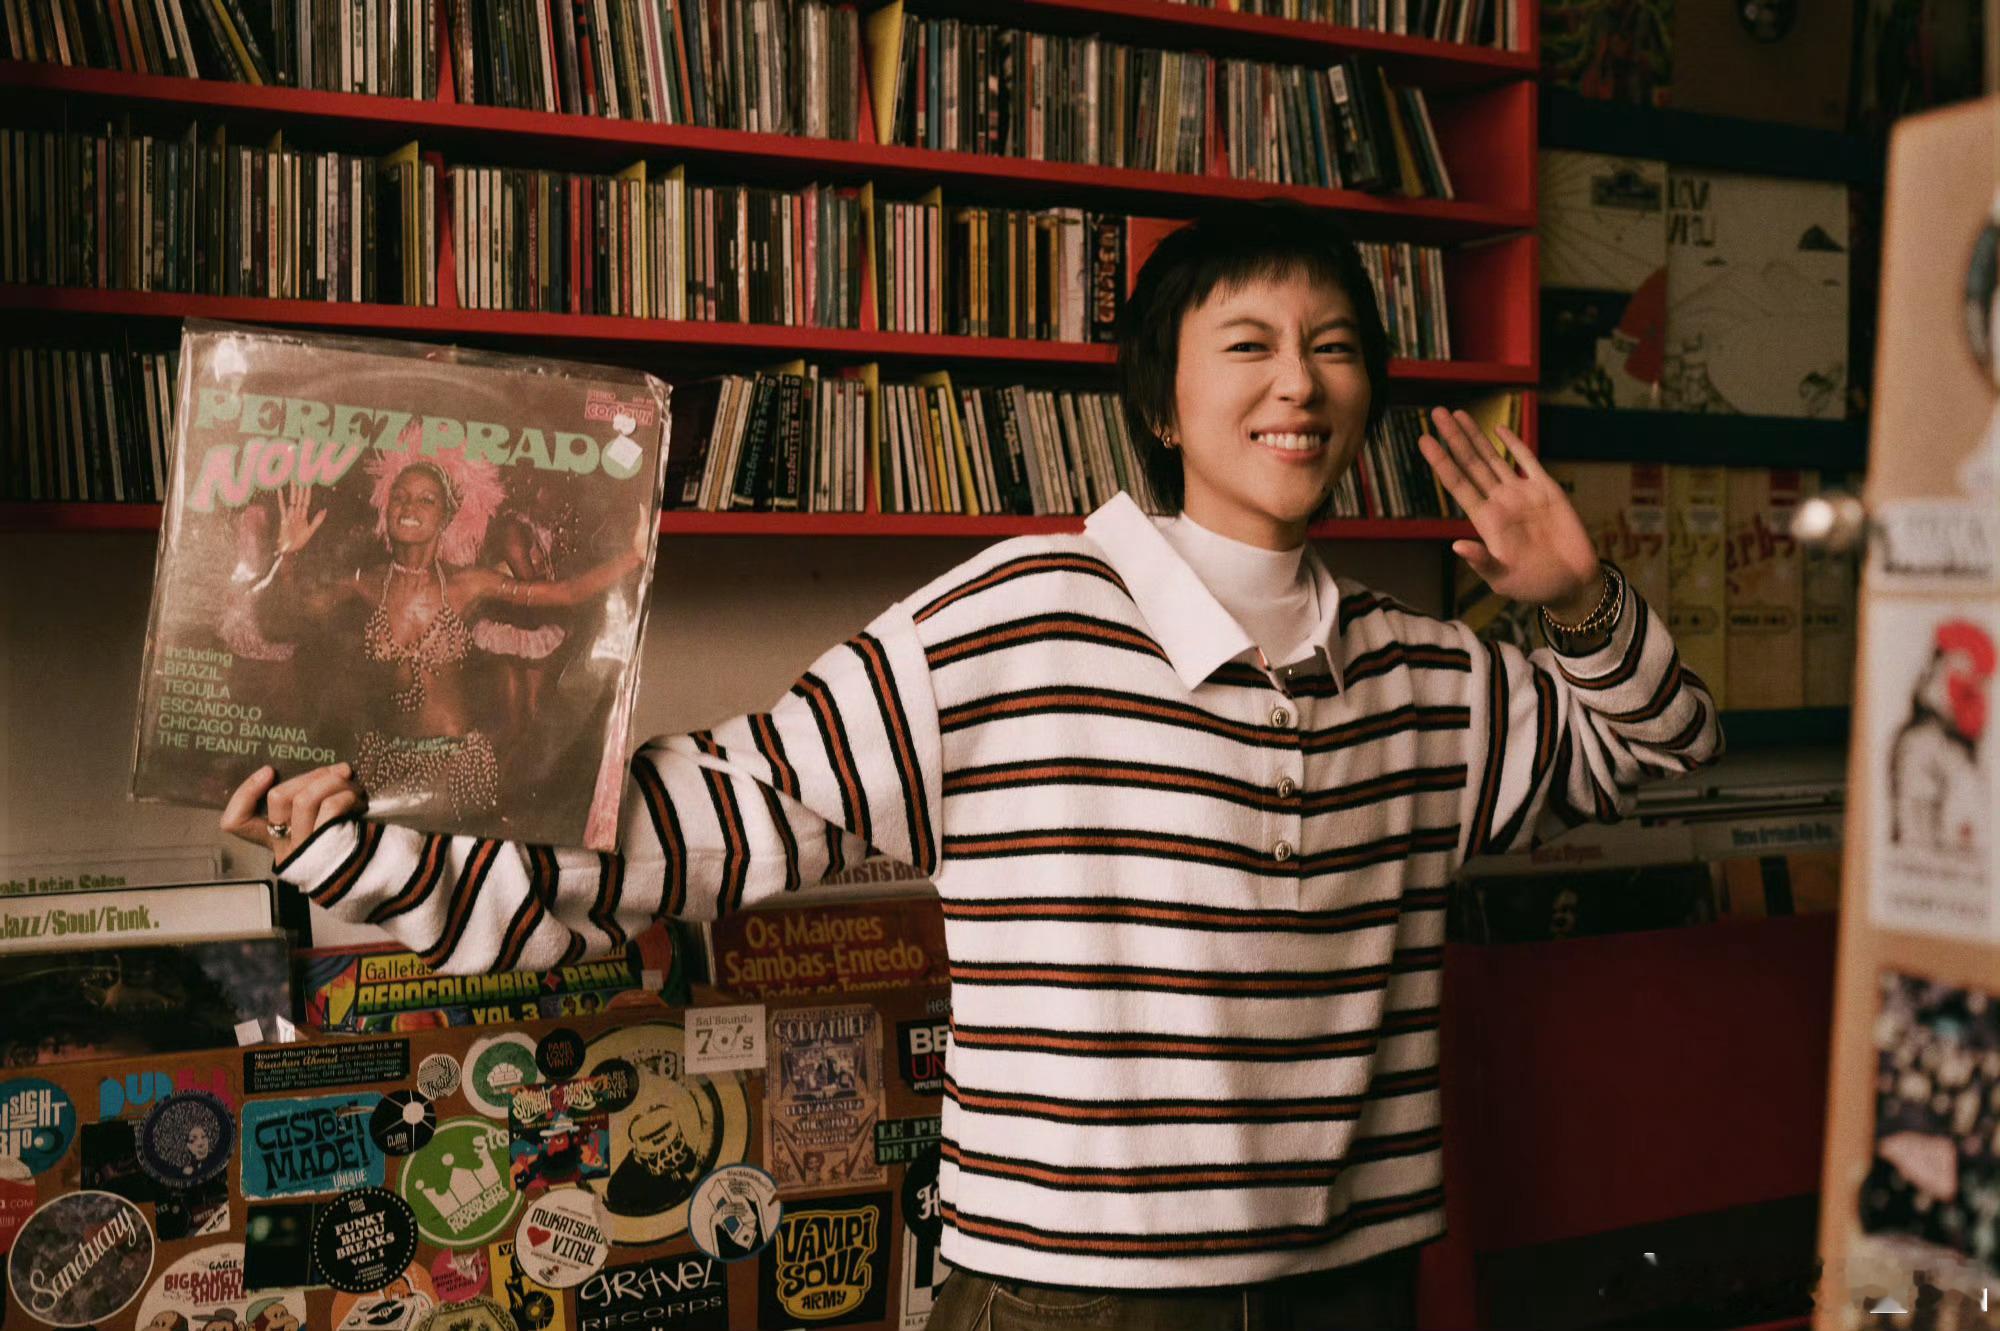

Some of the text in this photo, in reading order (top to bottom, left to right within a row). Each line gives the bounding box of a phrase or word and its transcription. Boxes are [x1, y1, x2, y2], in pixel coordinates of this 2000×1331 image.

[194, 387, 643, 480] PEREZ PRADO
[187, 436, 367, 513] NOW
[164, 660, 223, 681] BRAZIL
[164, 678, 231, 700] TEQUILA
[159, 696, 263, 722] ESCANDOLO
[158, 714, 308, 743] CHICAGO BANANA
[158, 731, 336, 763] THE PEANUT VENDOR
[745, 912, 885, 949] Os Maiores
[365, 960, 436, 982] Galletas
[724, 938, 926, 985] Sambas-Enredo
[356, 960, 632, 1013] AFROCOLOMBIA REMIX
[334, 1210, 387, 1236] FUNKY
[341, 1222, 386, 1248] BIJOU
[30, 1205, 138, 1314] Sanctuary
[335, 1231, 396, 1261] BREAKS
[552, 1233, 597, 1267] VINYL
[782, 1247, 867, 1298] SOUL
[801, 1290, 847, 1310] ARMY
